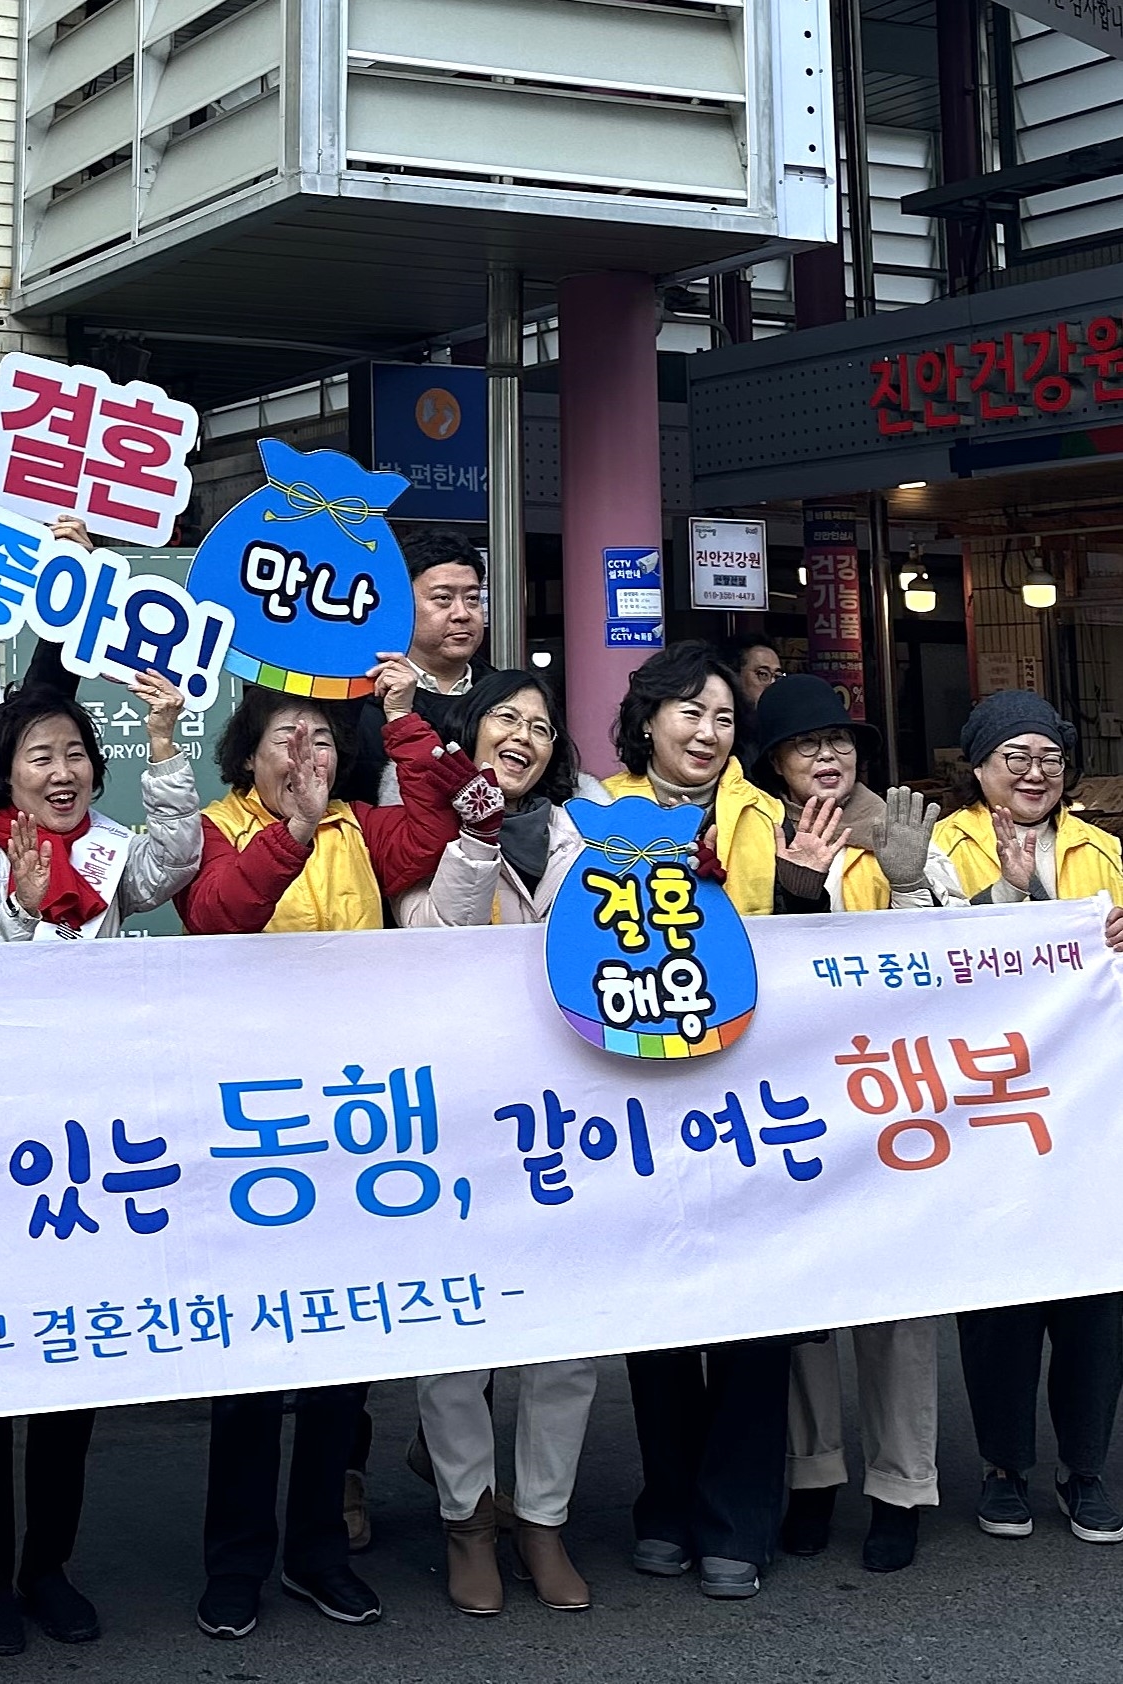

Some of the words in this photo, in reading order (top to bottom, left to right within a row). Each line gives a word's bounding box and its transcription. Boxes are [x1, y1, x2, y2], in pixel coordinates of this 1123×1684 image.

[869, 316, 1123, 436] 진안건강원
[1, 370, 184, 529] 결혼
[245, 543, 377, 622] 만나
[607, 559, 632, 569] CCTV
[608, 569, 642, 579] 설치안내
[696, 550, 761, 569] 진안건강원
[811, 554, 858, 581] 건강
[812, 583, 858, 611] 기능
[610, 632, 633, 641] CCTV
[814, 612, 860, 640] 식품
[79, 842, 116, 890] 전통
[587, 867, 700, 949] 결혼
[812, 956, 870, 987] 대구
[878, 951, 943, 988] 중심,
[947, 947, 1023, 984] 달서의
[1031, 941, 1085, 974] 시대
[598, 958, 712, 1037] 해용
[9, 1118, 182, 1240] 있는
[209, 1064, 472, 1227] 동행,
[493, 1088, 655, 1206] 같이
[680, 1080, 827, 1182] 여는
[835, 1032, 1053, 1171] 행복
[32, 1293, 234, 1364] 결혼친화
[250, 1273, 486, 1344] 서포터즈단
